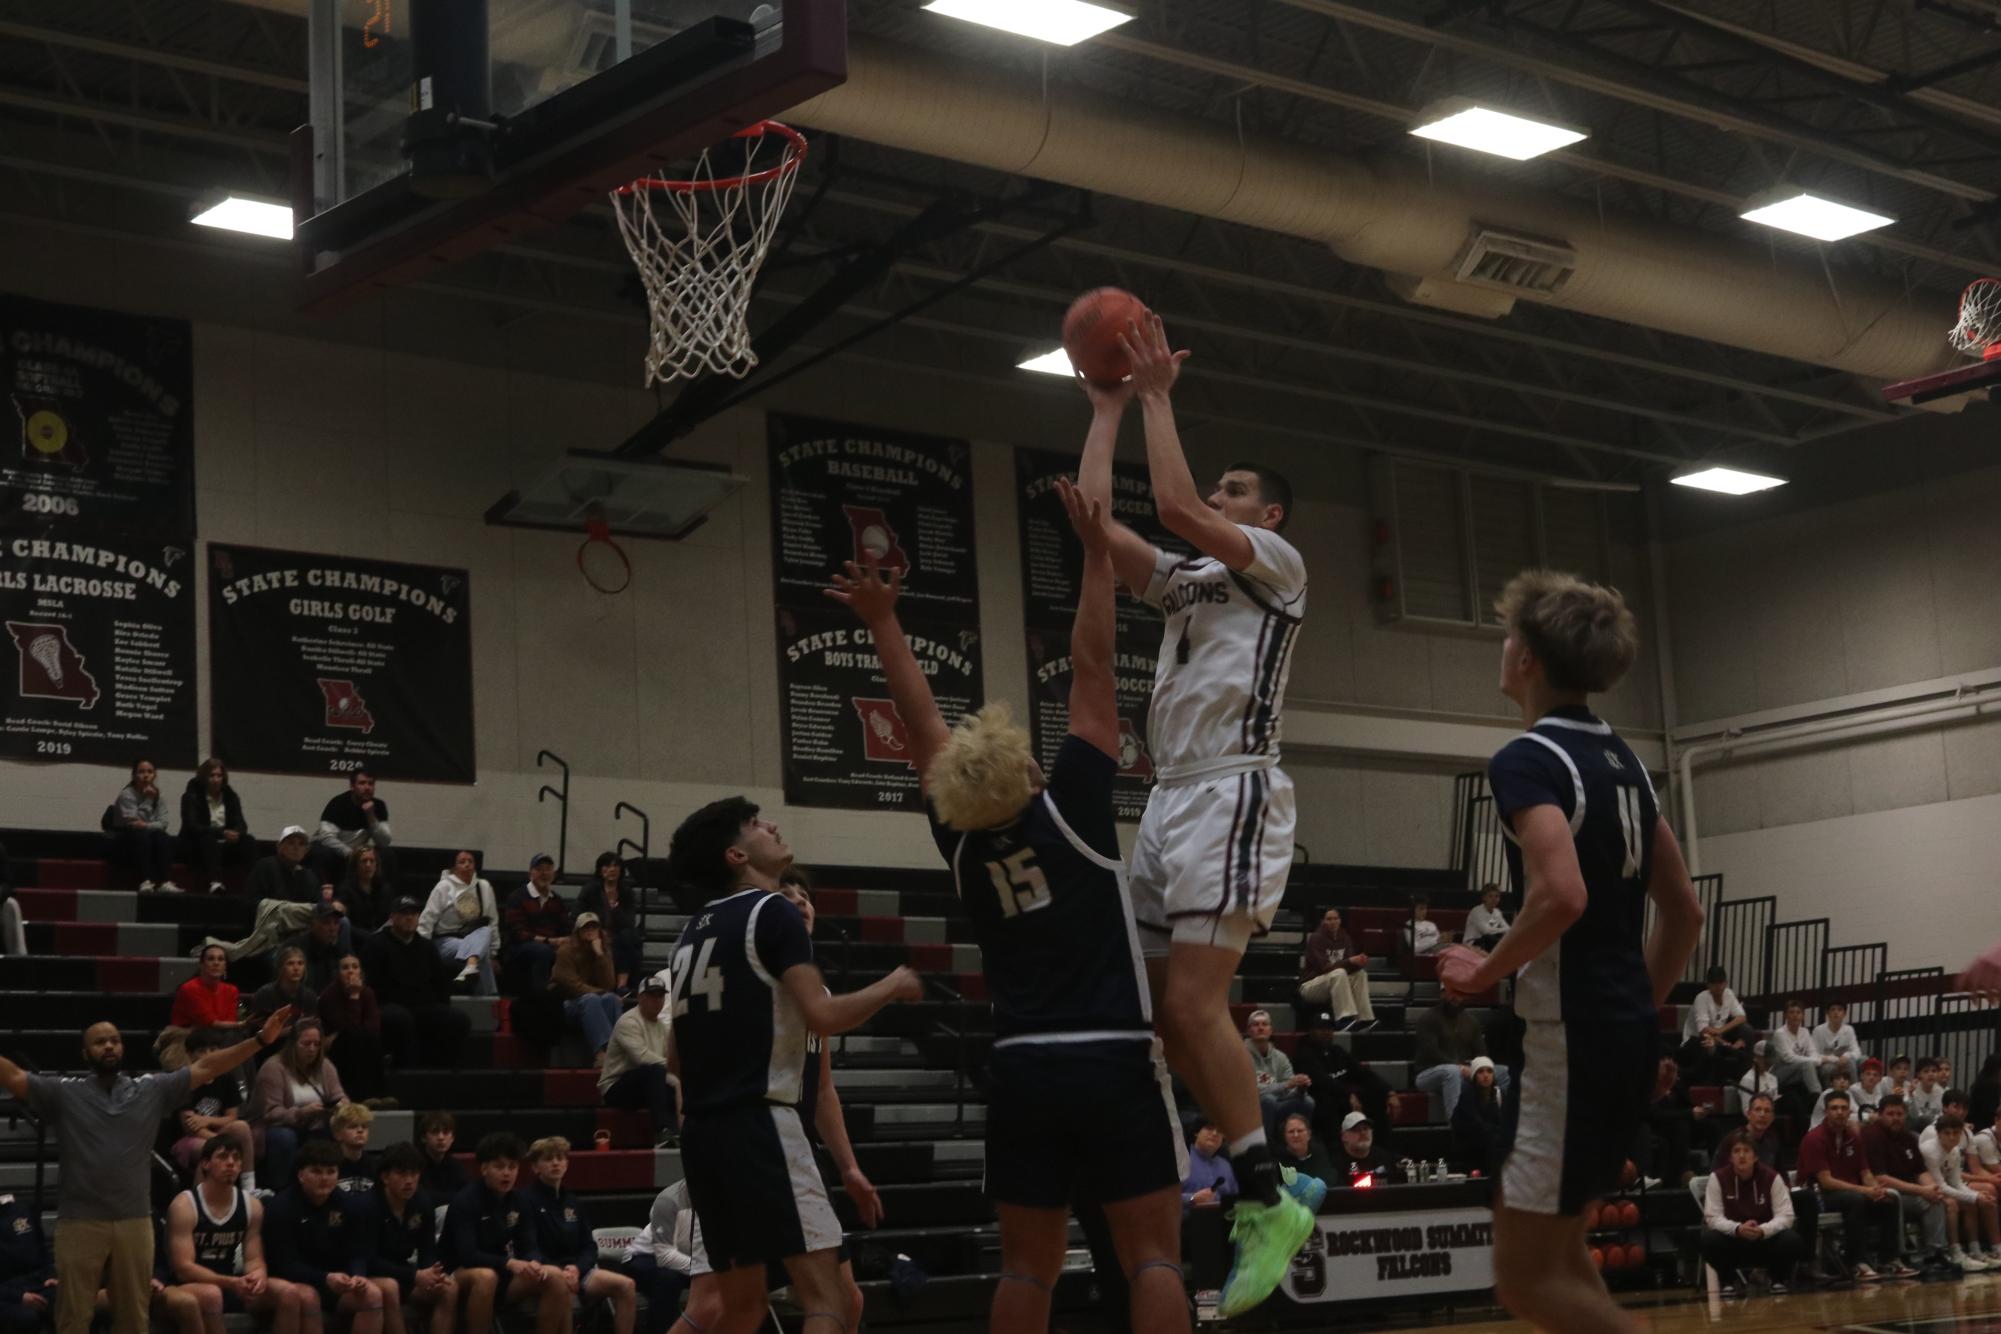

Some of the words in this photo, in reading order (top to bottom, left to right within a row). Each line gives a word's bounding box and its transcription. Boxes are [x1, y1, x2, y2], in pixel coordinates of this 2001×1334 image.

[11, 330, 180, 417] CHAMPIONS
[779, 438, 838, 467] STATE
[844, 438, 964, 490] CHAMPIONS
[827, 460, 919, 486] BASEBALL
[22, 493, 80, 516] 2006
[12, 539, 182, 598] CHAMPIONS
[33, 573, 137, 600] LACROSSE
[222, 569, 299, 605] STATE
[307, 569, 458, 624] CHAMPIONS
[289, 598, 343, 619] GIRLS
[348, 604, 396, 624] GOLF
[786, 629, 847, 663] STATE
[825, 651, 854, 668] BOYS
[856, 654, 884, 669] TRA
[1038, 655, 1073, 684] STA
[1113, 677, 1155, 693] SOCCE
[37, 740, 72, 754] 2019
[877, 791, 904, 803] 2017
[984, 846, 1053, 919] 15
[671, 937, 725, 1020] 24
[598, 1236, 636, 1249] SUMM
[1326, 1227, 1423, 1256] ROCKWOOD
[1377, 1252, 1452, 1280] FALCONS
